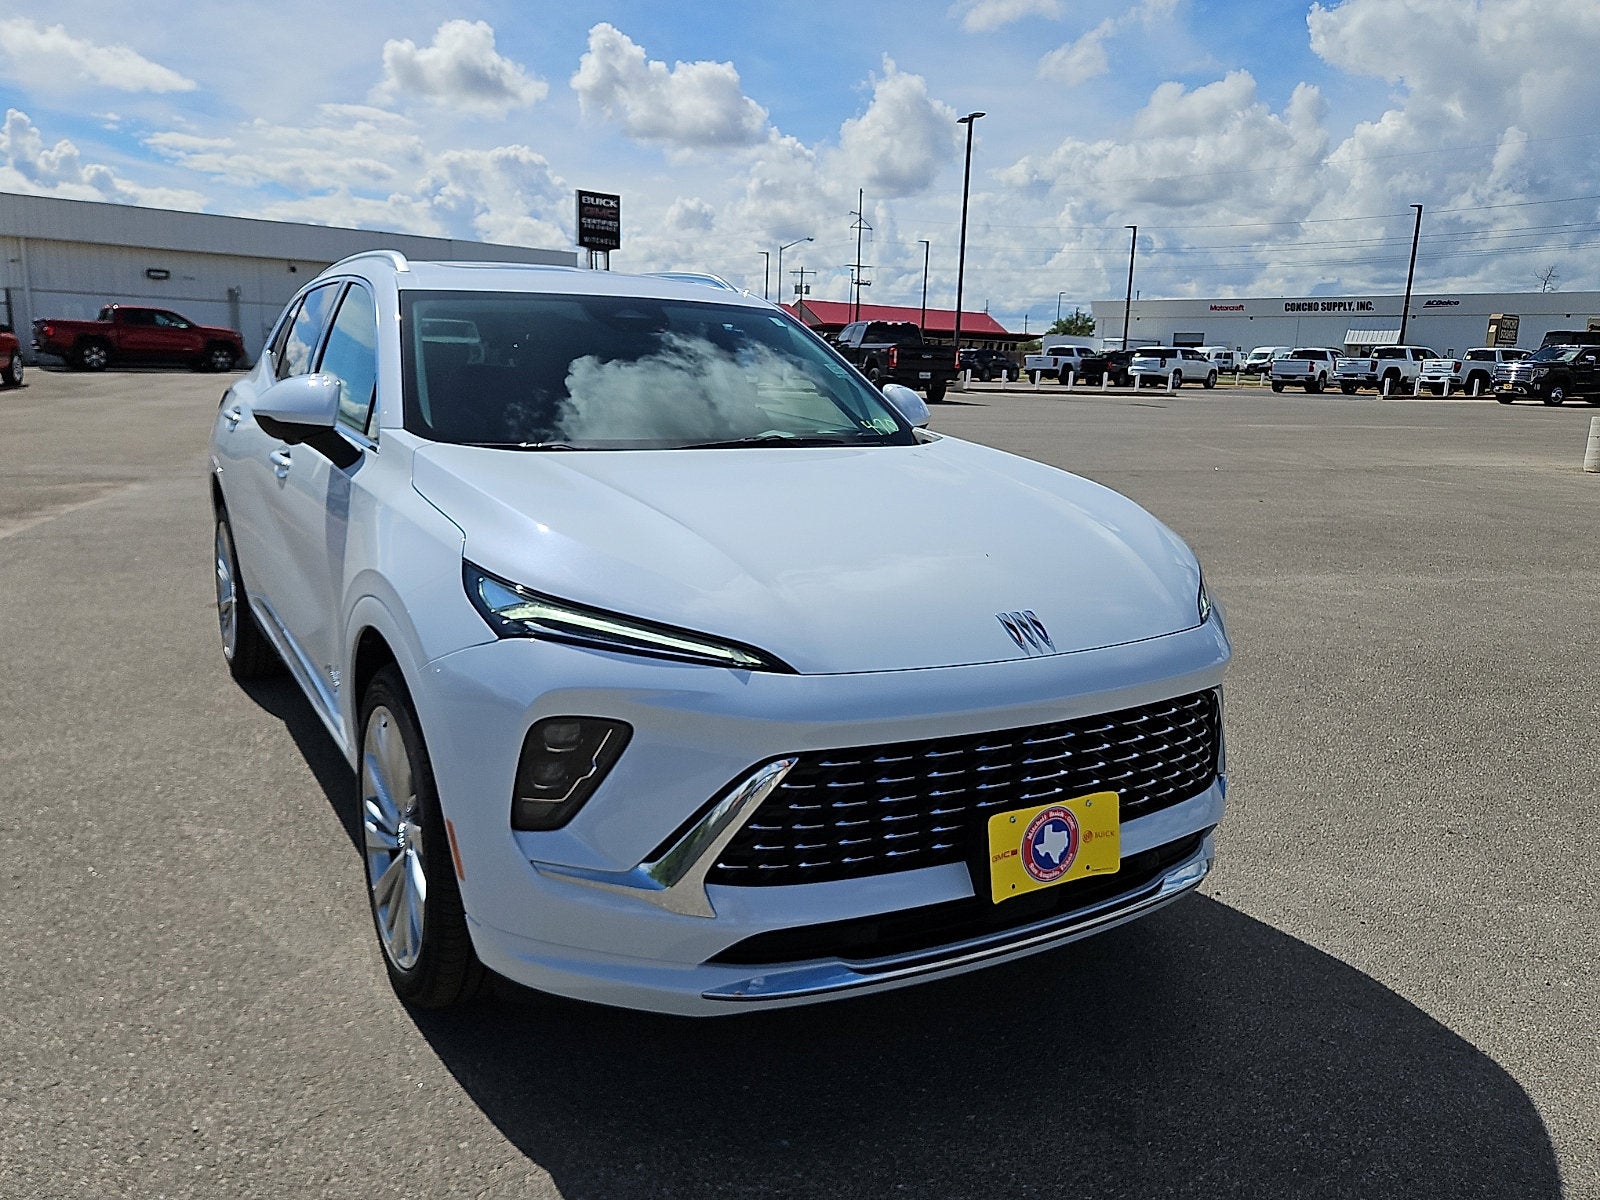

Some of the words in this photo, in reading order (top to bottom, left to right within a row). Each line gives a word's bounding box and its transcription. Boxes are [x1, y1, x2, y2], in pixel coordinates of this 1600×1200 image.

[581, 196, 618, 207] BUICK
[584, 207, 617, 218] GMC
[1209, 304, 1245, 312] Motorcraft
[1284, 302, 1320, 312] CONCHO
[1320, 300, 1355, 312] SUPPLY,
[1356, 300, 1375, 311] INC.
[1424, 299, 1460, 307] ACDelco
[991, 850, 1010, 863] GMC
